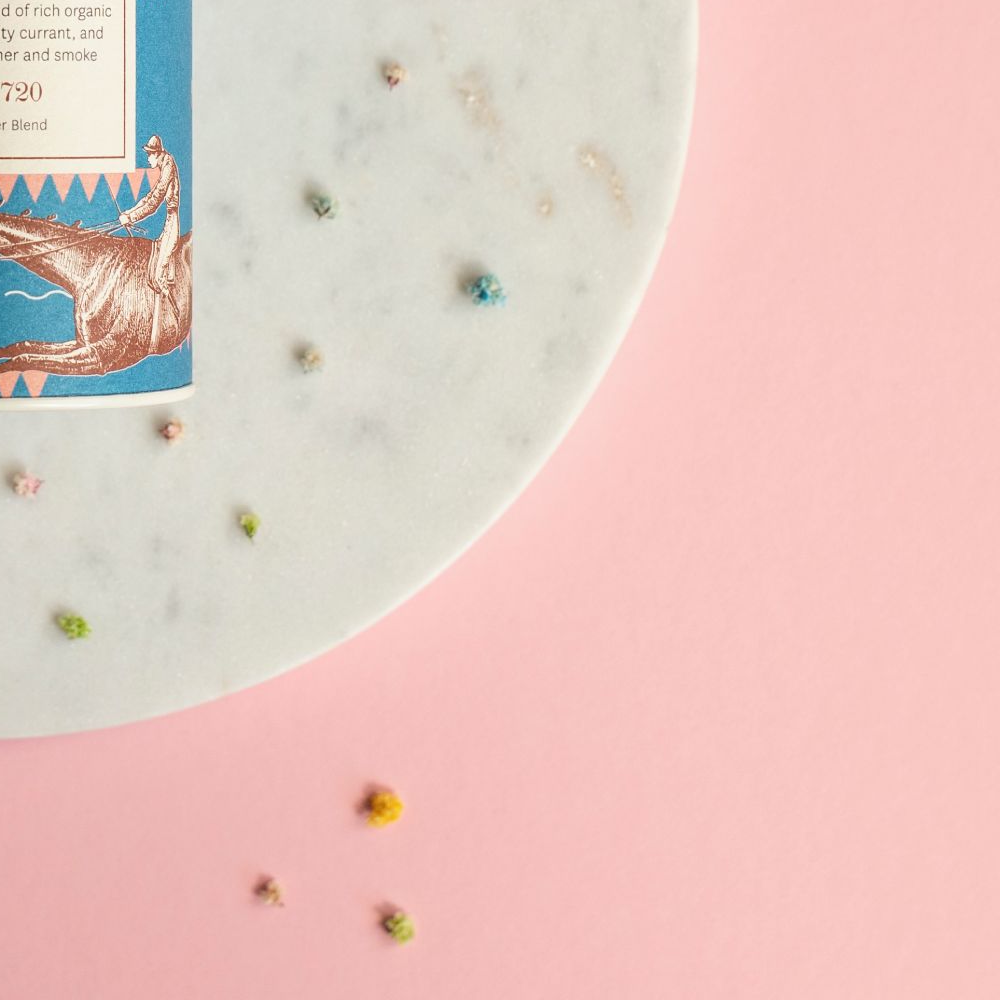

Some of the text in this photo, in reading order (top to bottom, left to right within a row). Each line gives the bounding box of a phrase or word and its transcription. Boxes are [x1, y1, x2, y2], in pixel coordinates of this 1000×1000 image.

[15, 3, 31, 17] of
[33, 3, 60, 17] rich
[64, 3, 112, 21] organic
[19, 27, 76, 42] currant,
[80, 25, 104, 40] and
[23, 47, 50, 62] and
[54, 47, 98, 62] smoke
[0, 81, 43, 102] 720
[11, 118, 48, 131] Blend
